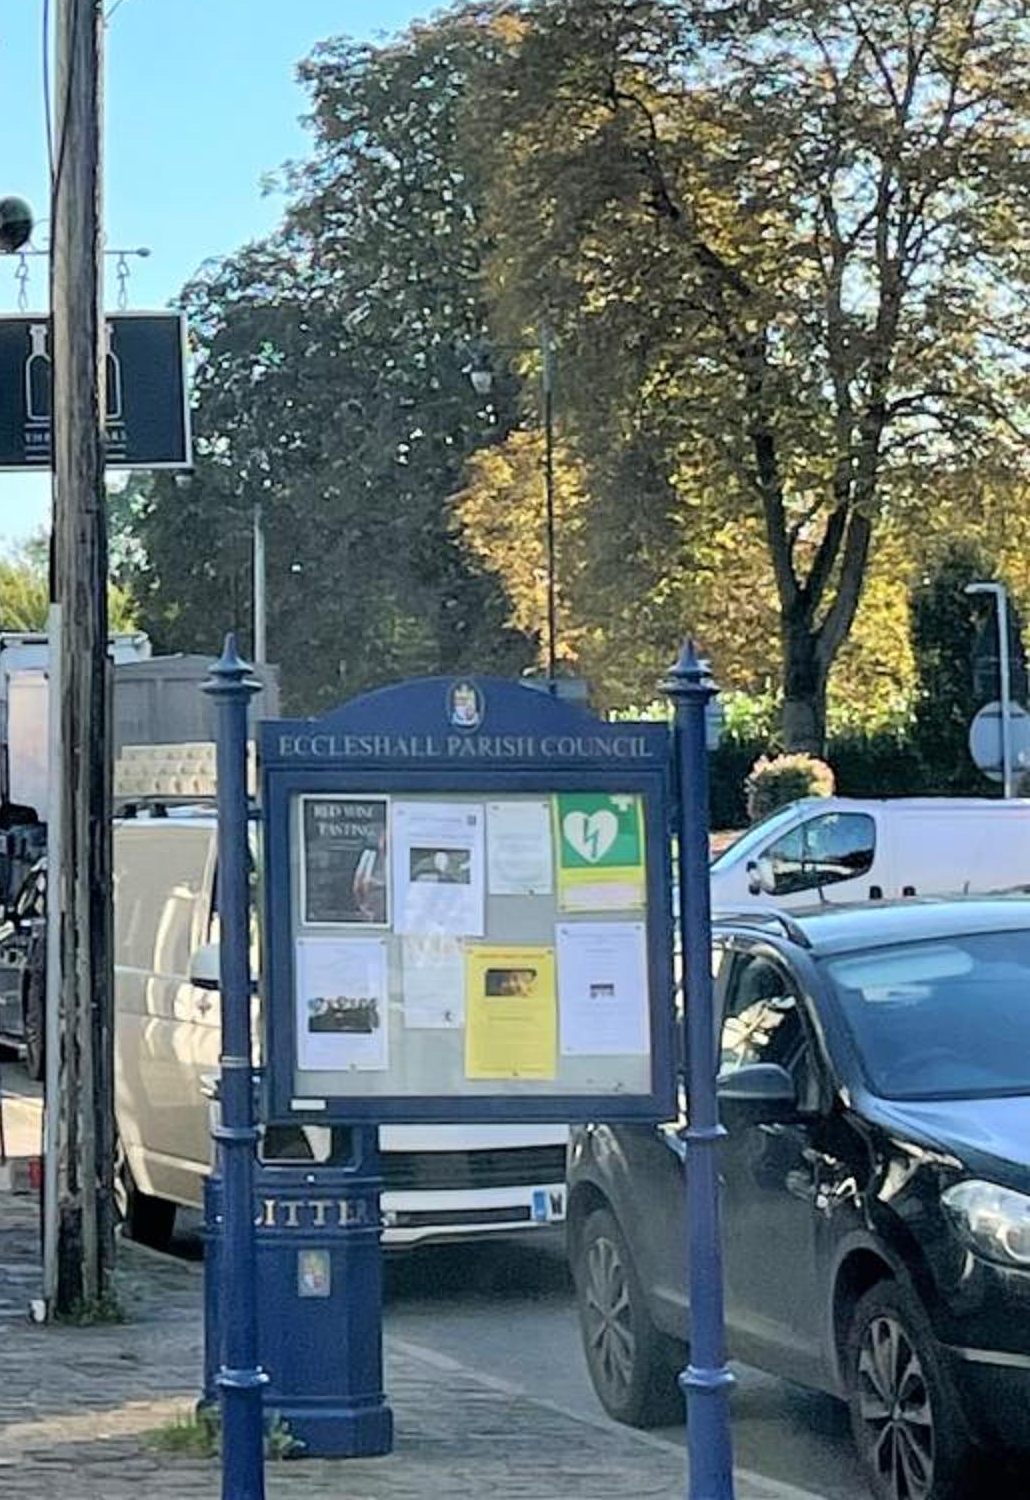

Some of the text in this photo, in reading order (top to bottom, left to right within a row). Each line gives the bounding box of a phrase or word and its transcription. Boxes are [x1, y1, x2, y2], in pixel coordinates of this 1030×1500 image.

[279, 735, 654, 757] ECCLESHALL PARISH COUNCIL
[256, 1199, 372, 1226] ITTER
